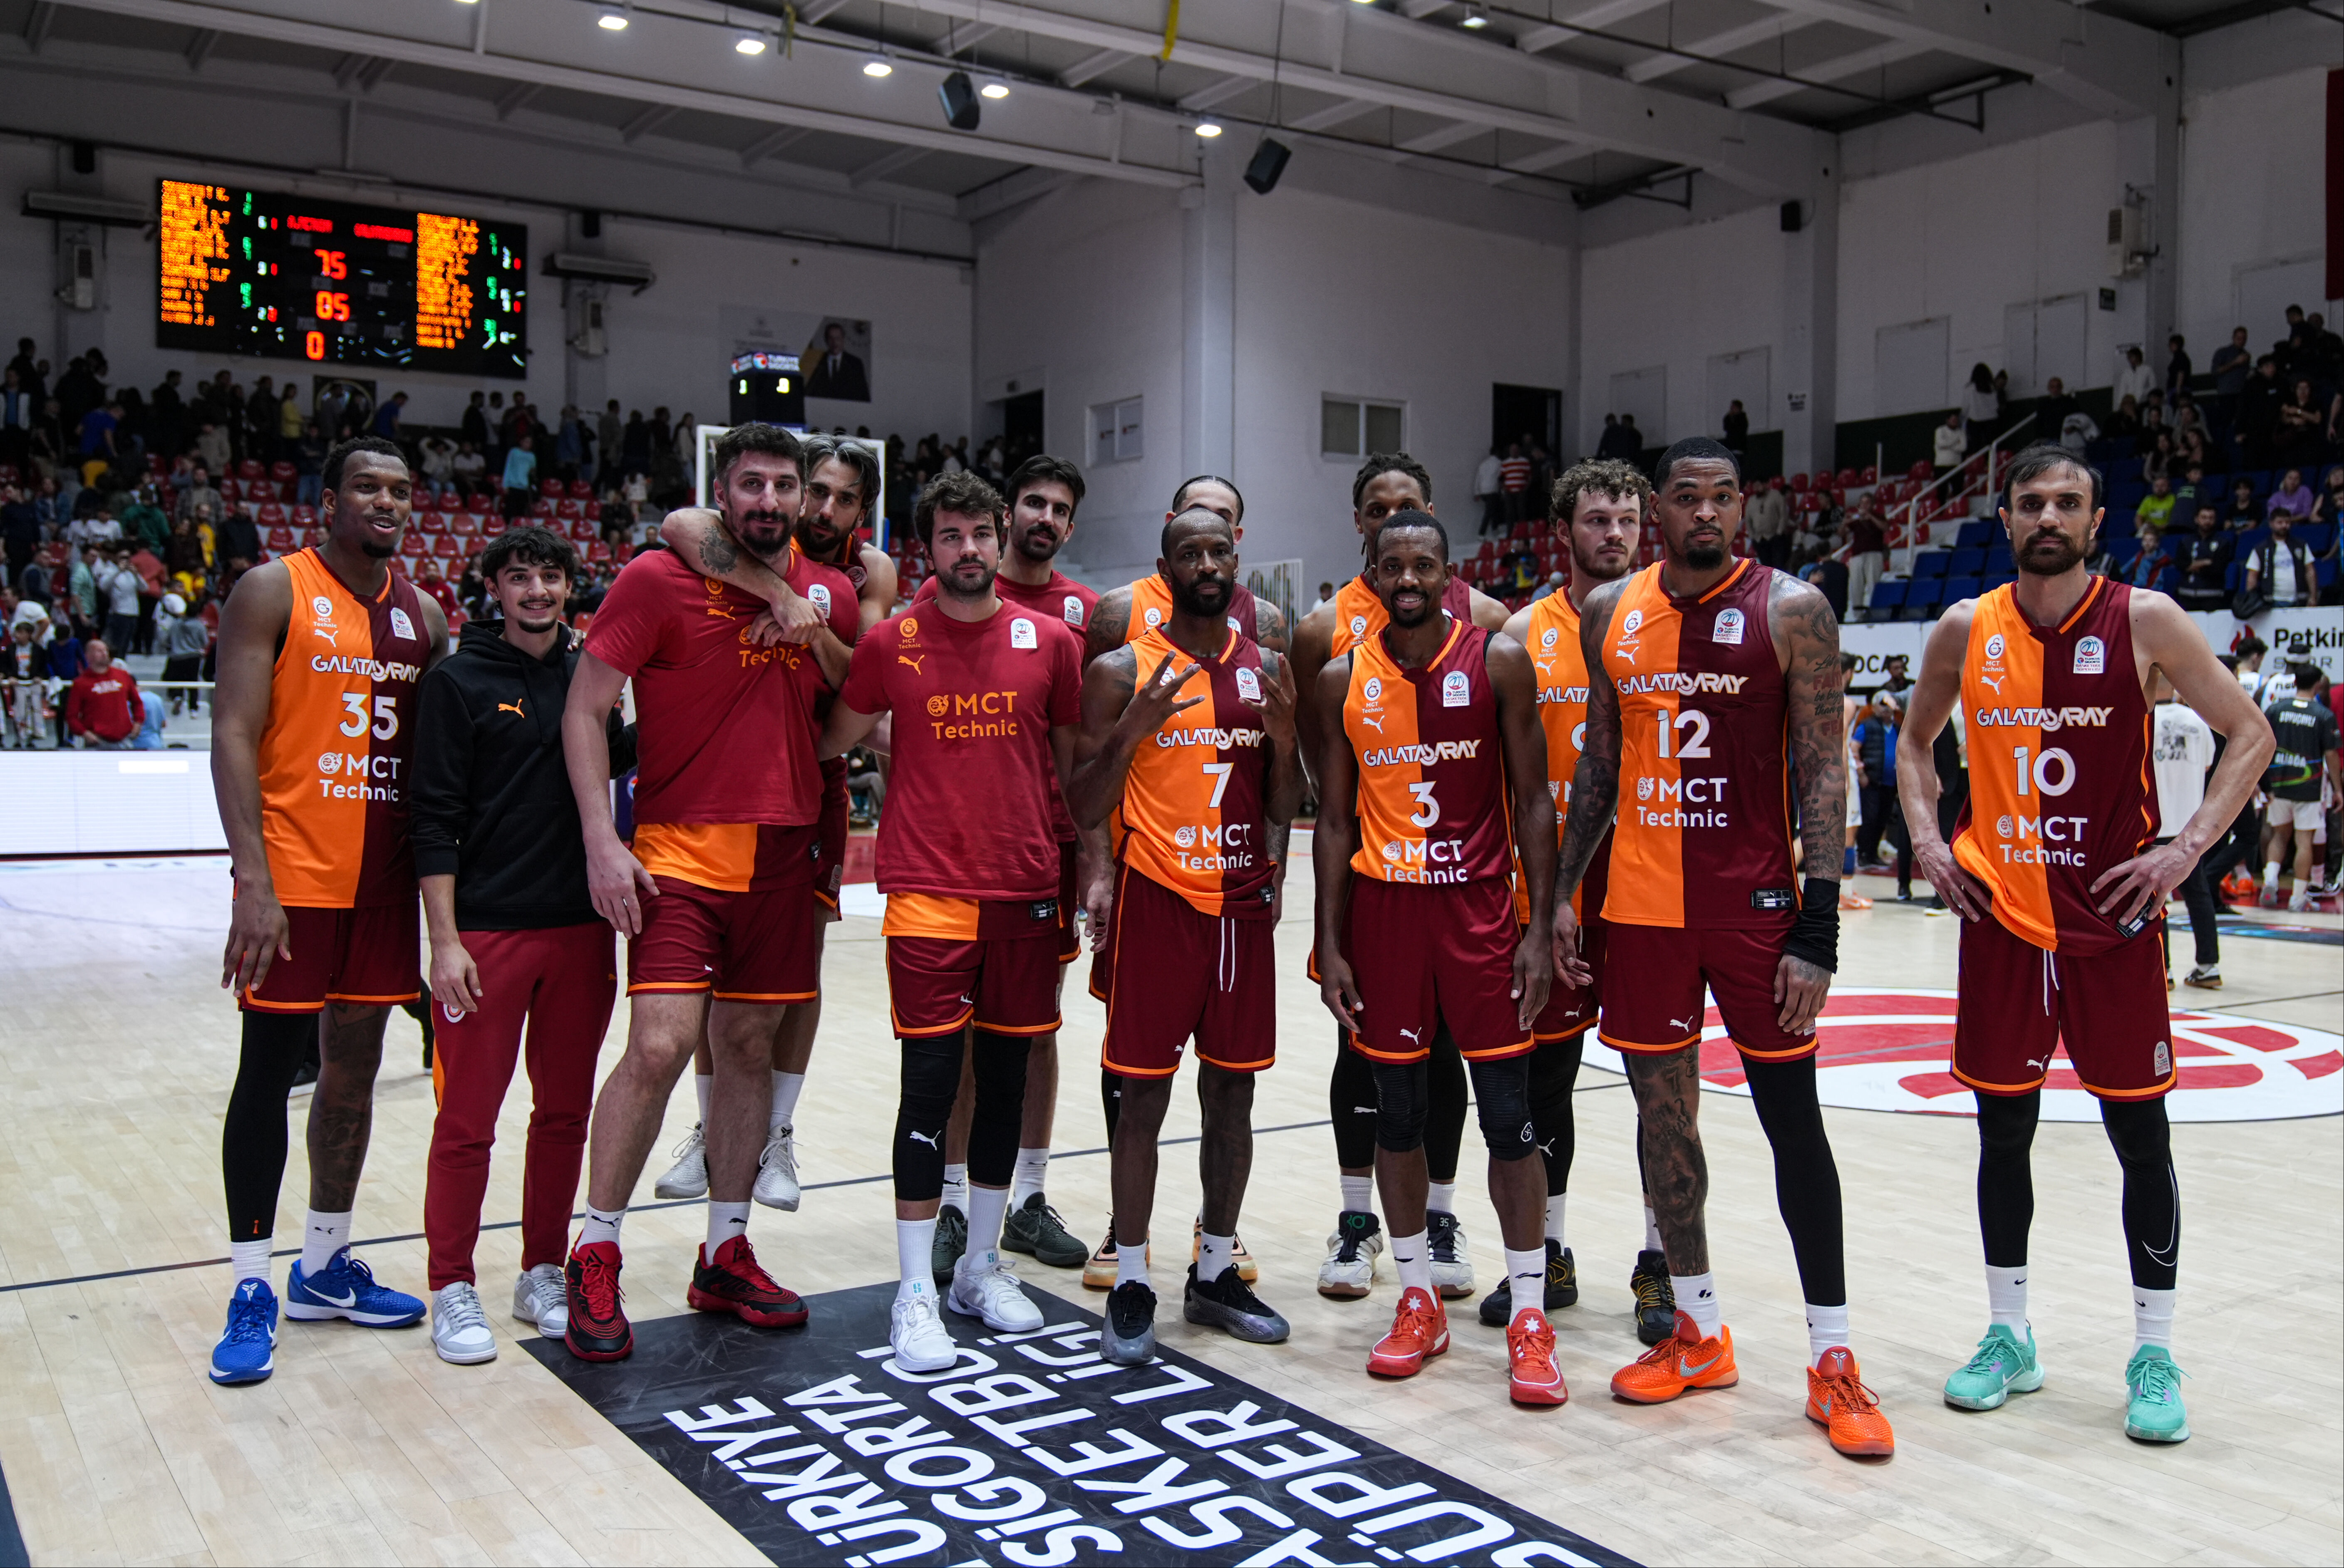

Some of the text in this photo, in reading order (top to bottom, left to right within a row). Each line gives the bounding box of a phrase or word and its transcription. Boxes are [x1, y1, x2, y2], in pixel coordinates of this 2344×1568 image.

[314, 249, 347, 280] 75
[306, 331, 324, 360] 0
[311, 654, 420, 683] GALATASARAY
[1617, 673, 1749, 696] GALATASARAY
[955, 691, 1018, 716] MCT
[339, 692, 399, 741] 35
[1976, 707, 2114, 732] GALATASARAY
[932, 720, 1018, 740] Technic
[1156, 728, 1266, 751] GALATASARAY
[1656, 709, 1711, 759] 12
[1363, 739, 1481, 766] GALATASARAY
[347, 754, 401, 779] MCT
[2013, 746, 2076, 797] 10
[320, 779, 399, 802] Technic
[1202, 763, 1234, 808] 7
[1659, 778, 1728, 802] MCT
[1409, 781, 1440, 828] 3
[1637, 806, 1728, 827] Technic
[1202, 824, 1250, 848] MCT
[2019, 816, 2088, 841] MCT
[1177, 851, 1253, 871] Technic
[1405, 840, 1462, 862] MCT
[1999, 844, 2086, 867] Technic
[1383, 865, 1468, 884] Technic
[1439, 1217, 1449, 1227] 35
[663, 1396, 995, 1568] ÜRKİYE
[783, 1373, 1124, 1567] SİGORTA
